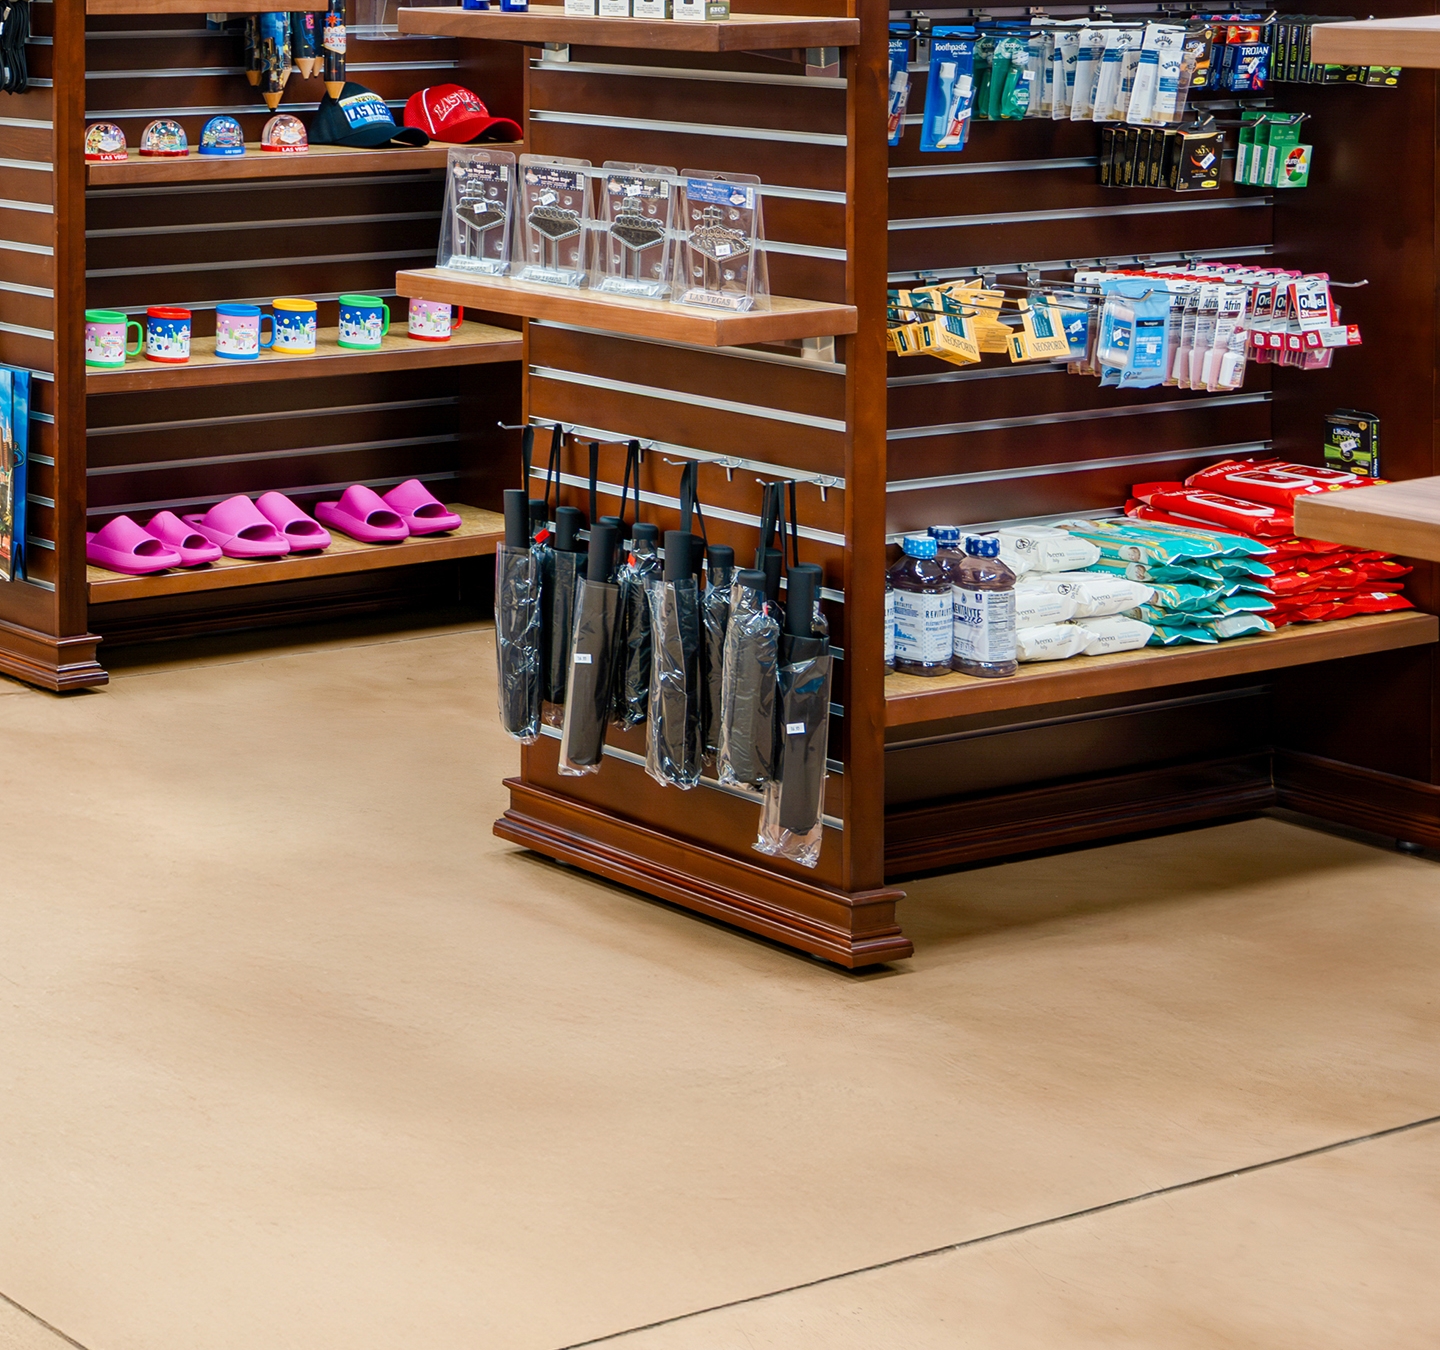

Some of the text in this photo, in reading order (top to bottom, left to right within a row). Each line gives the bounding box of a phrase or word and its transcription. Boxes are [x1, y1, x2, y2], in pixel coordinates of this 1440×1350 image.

[935, 42, 968, 53] Toothpaste
[1242, 46, 1269, 56] TROJAN
[434, 94, 461, 121] LAS
[346, 105, 367, 122] LAS
[689, 293, 731, 306] LAS VEGAS
[1224, 300, 1241, 311] Afrin
[1255, 308, 1263, 317] 3X
[1274, 309, 1281, 317] 3X
[1301, 310, 1310, 318] 3X
[942, 333, 976, 354] NEOSPORIN
[1032, 340, 1066, 352] NEOSPORIN
[1333, 428, 1361, 438] LifeStyles
[1223, 463, 1246, 474] Wipes
[964, 615, 983, 624] ZERO
